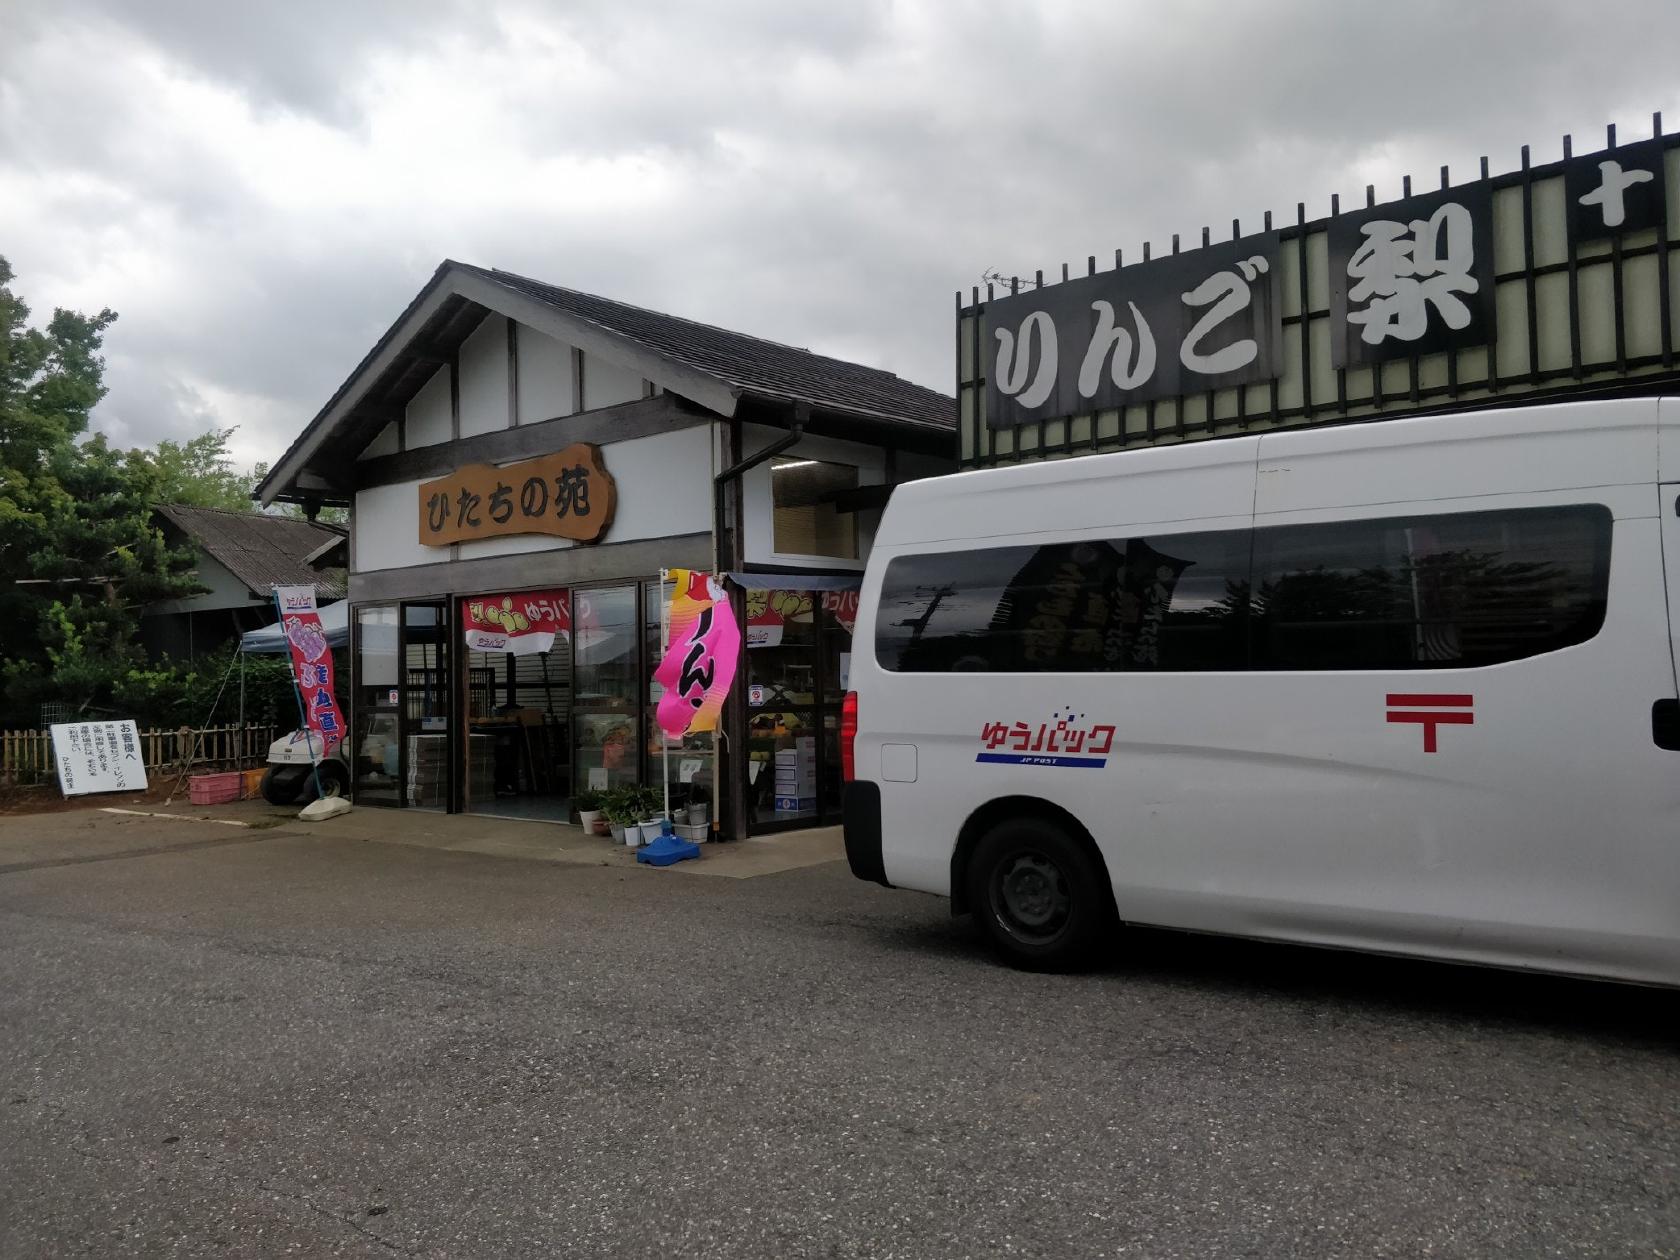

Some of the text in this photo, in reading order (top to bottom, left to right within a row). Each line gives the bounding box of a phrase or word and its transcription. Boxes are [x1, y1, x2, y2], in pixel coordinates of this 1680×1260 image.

[1346, 202, 1480, 345] 梨
[995, 255, 1270, 409] りんご
[427, 463, 591, 533] ひたちの苑
[981, 720, 1117, 754] ゆうパック
[1033, 757, 1058, 765] POST
